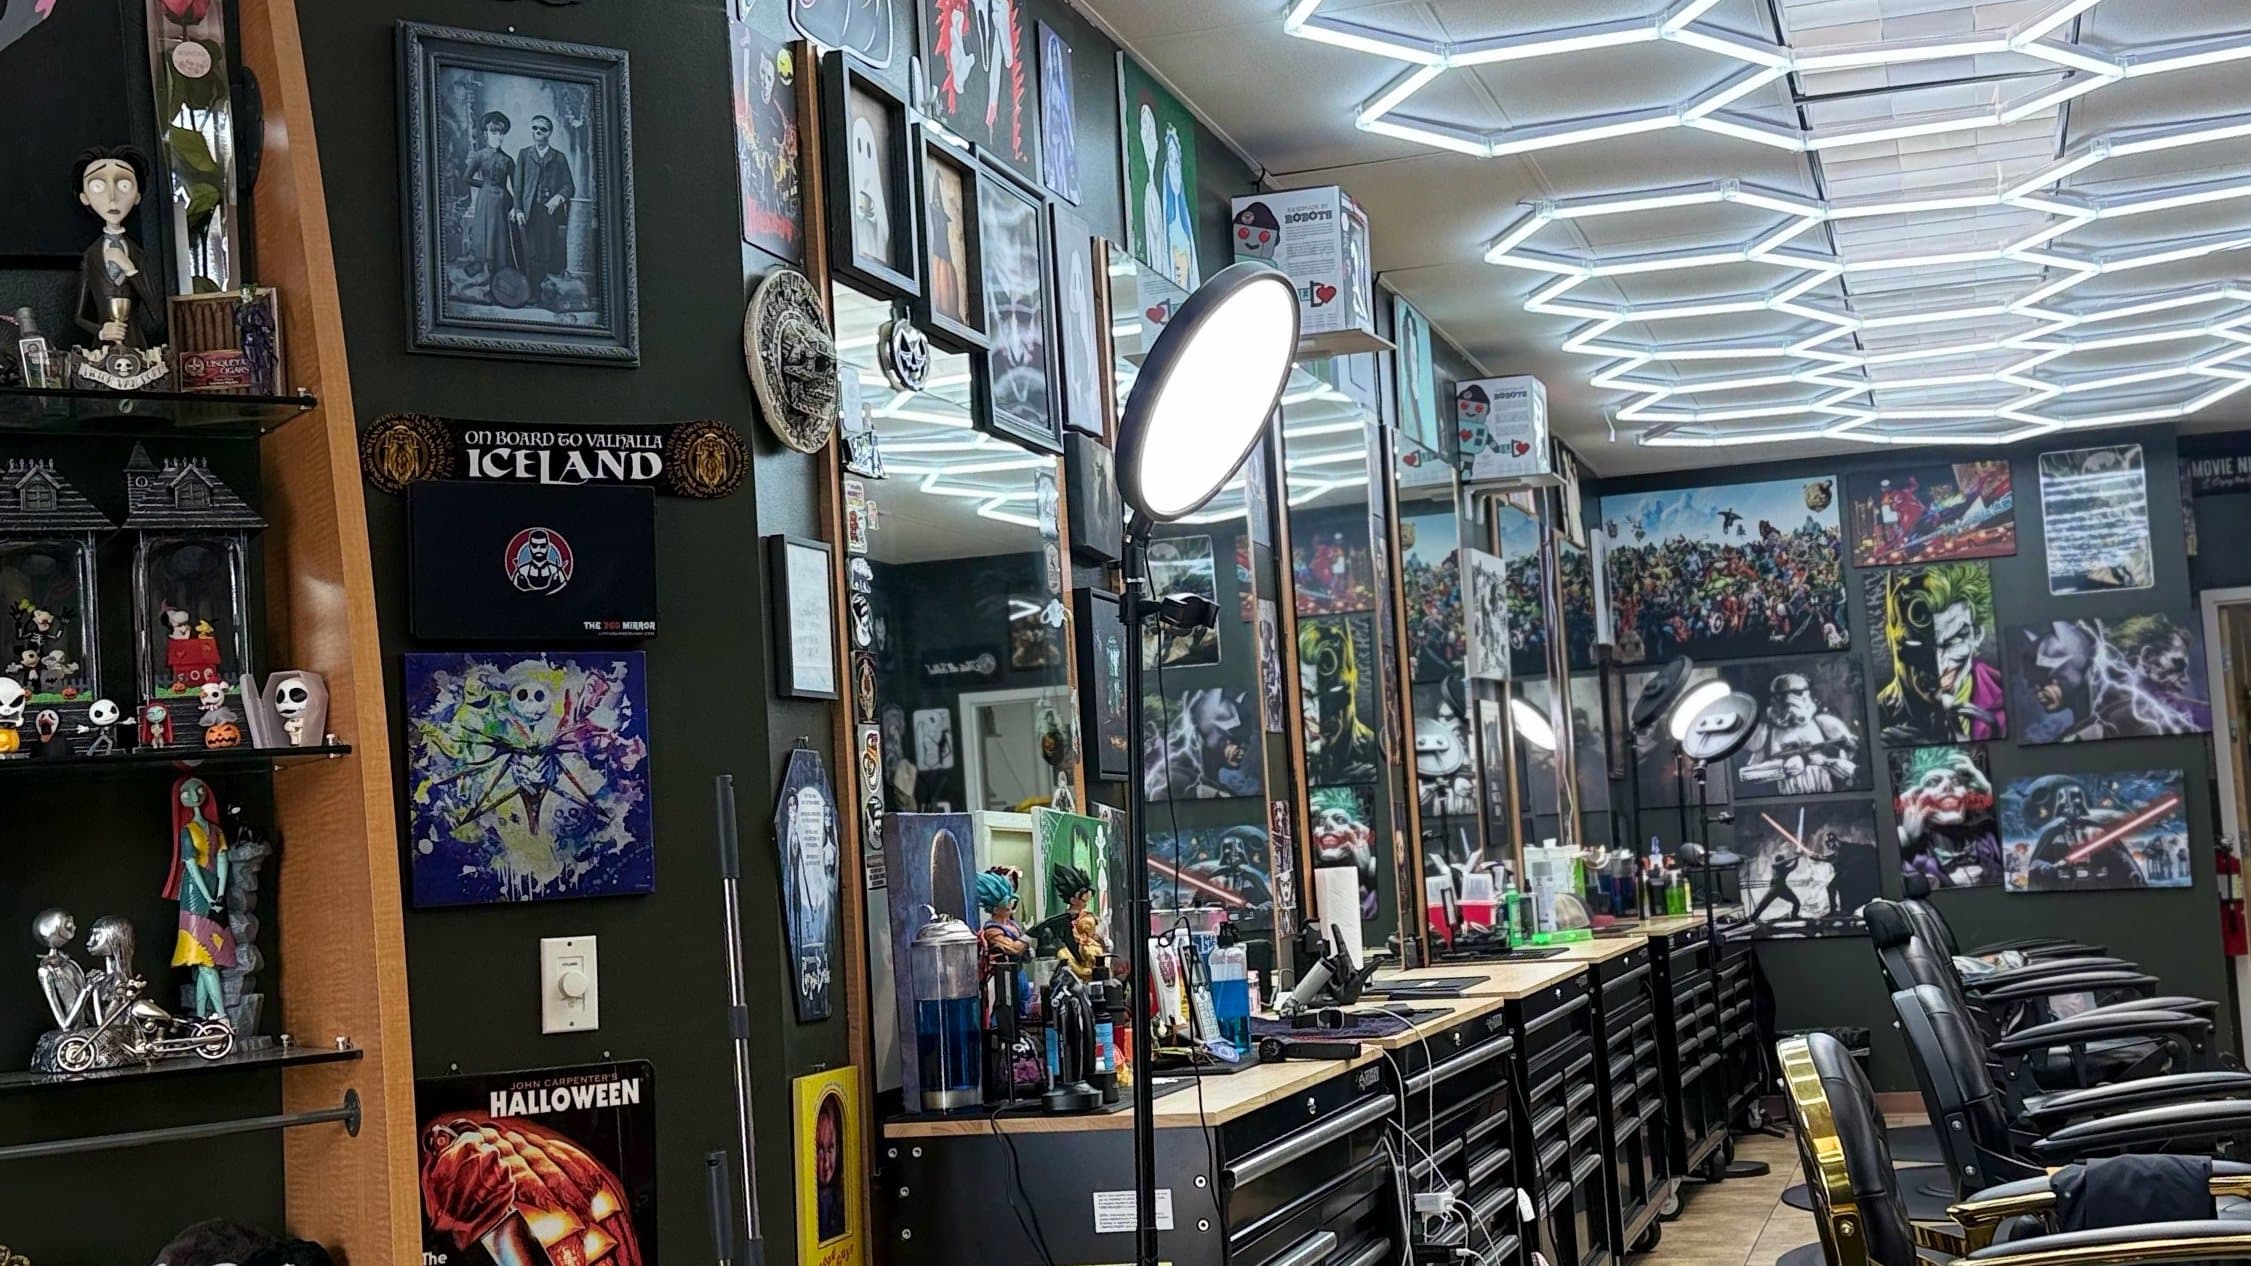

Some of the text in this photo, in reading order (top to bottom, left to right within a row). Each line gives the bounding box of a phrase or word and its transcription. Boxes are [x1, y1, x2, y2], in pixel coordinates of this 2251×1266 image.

[1285, 210, 1332, 224] ROBOTS
[465, 431, 663, 449] ON BOARD TO VALHALLA
[466, 448, 663, 485] ICELAND
[2191, 458, 2233, 477] MOVIE
[584, 621, 601, 630] THE
[622, 621, 655, 630] MIRROR
[510, 1072, 617, 1090] JOHN CARPENTER'S
[490, 1078, 640, 1118] HALLOWEEN
[422, 1251, 448, 1266] The
